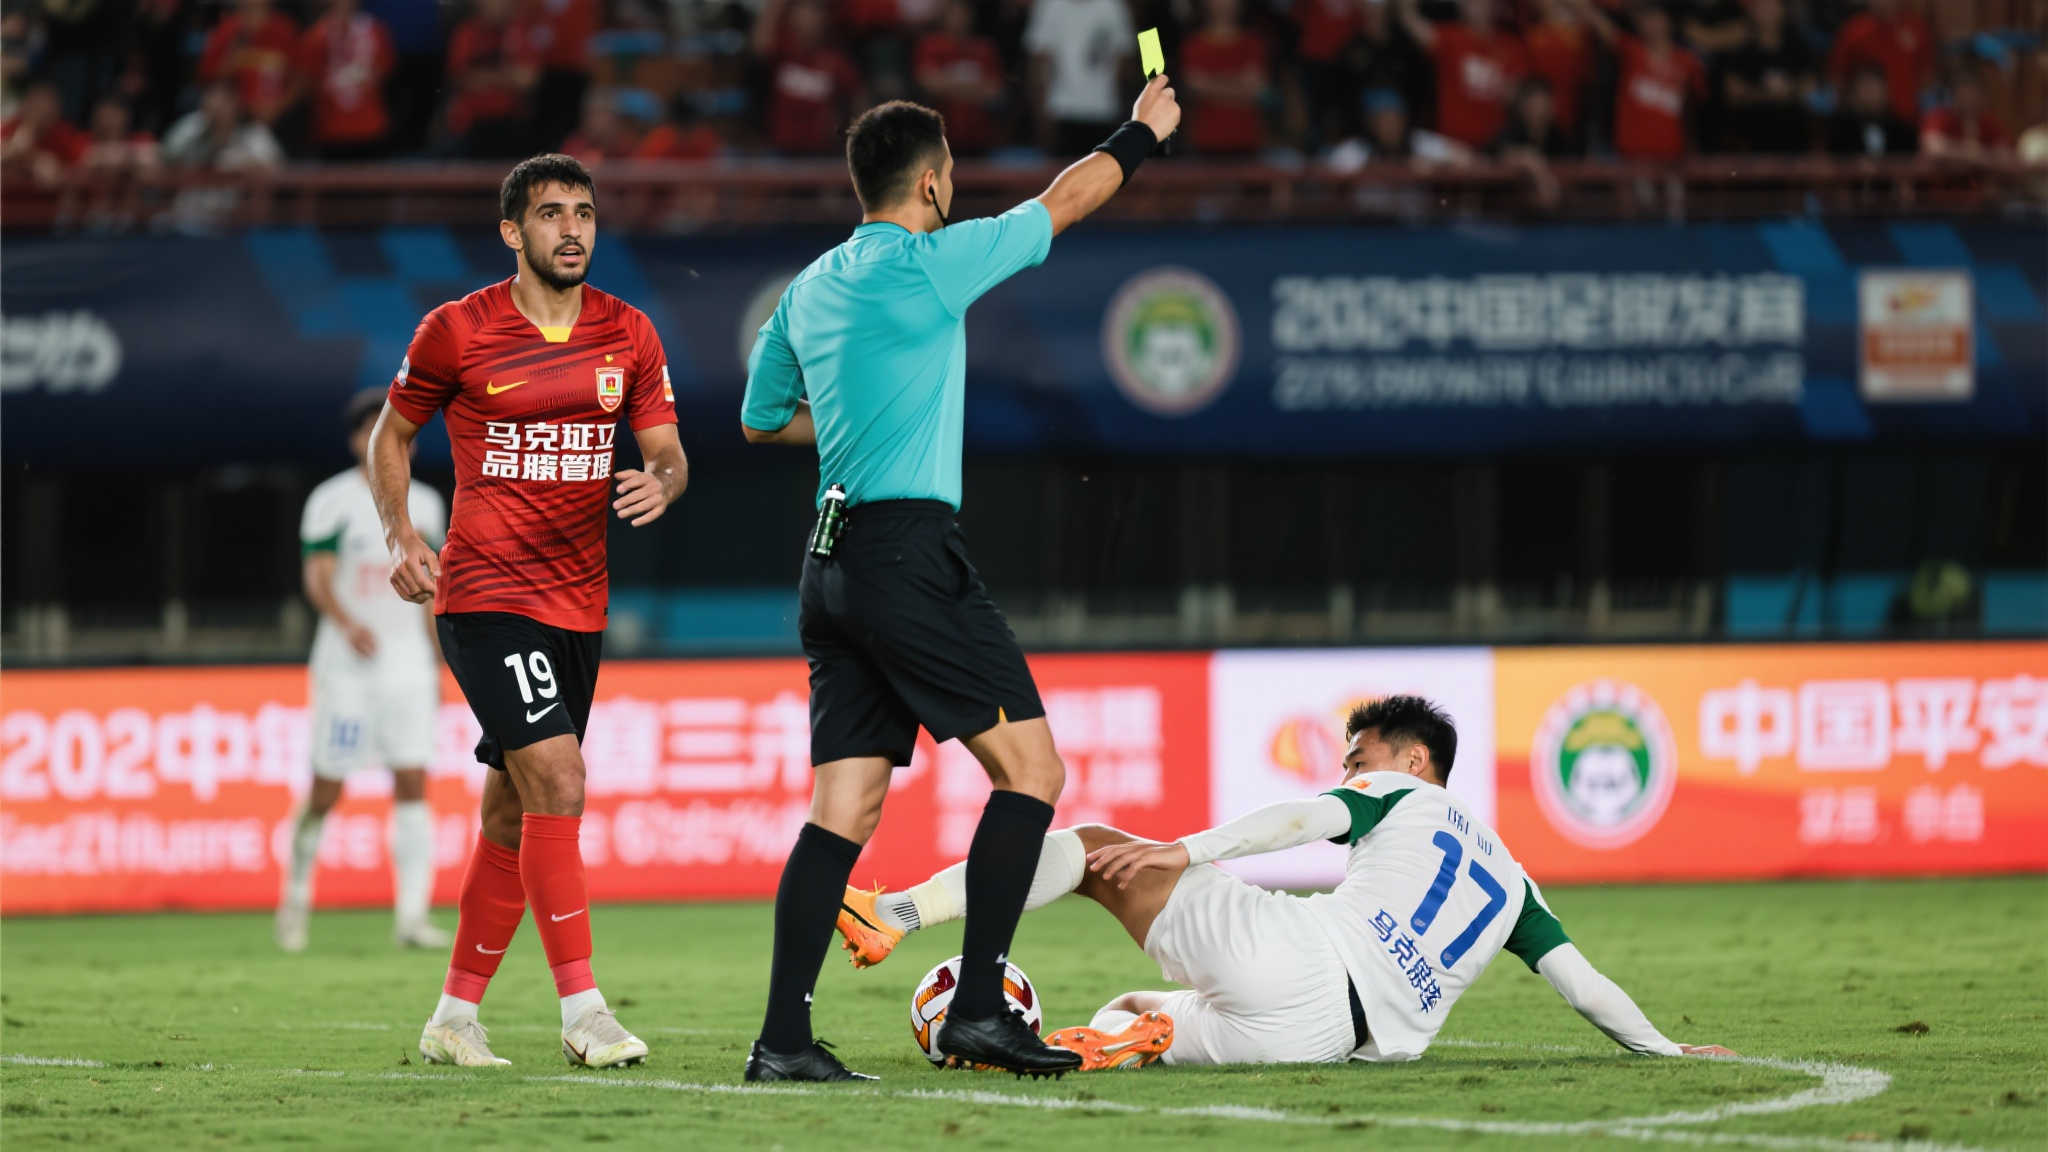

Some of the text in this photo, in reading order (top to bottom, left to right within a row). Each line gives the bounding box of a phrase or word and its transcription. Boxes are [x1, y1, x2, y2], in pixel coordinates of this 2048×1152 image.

[504, 650, 558, 703] 19
[1700, 676, 2048, 774] 中国平安
[1410, 830, 1507, 970] 17
